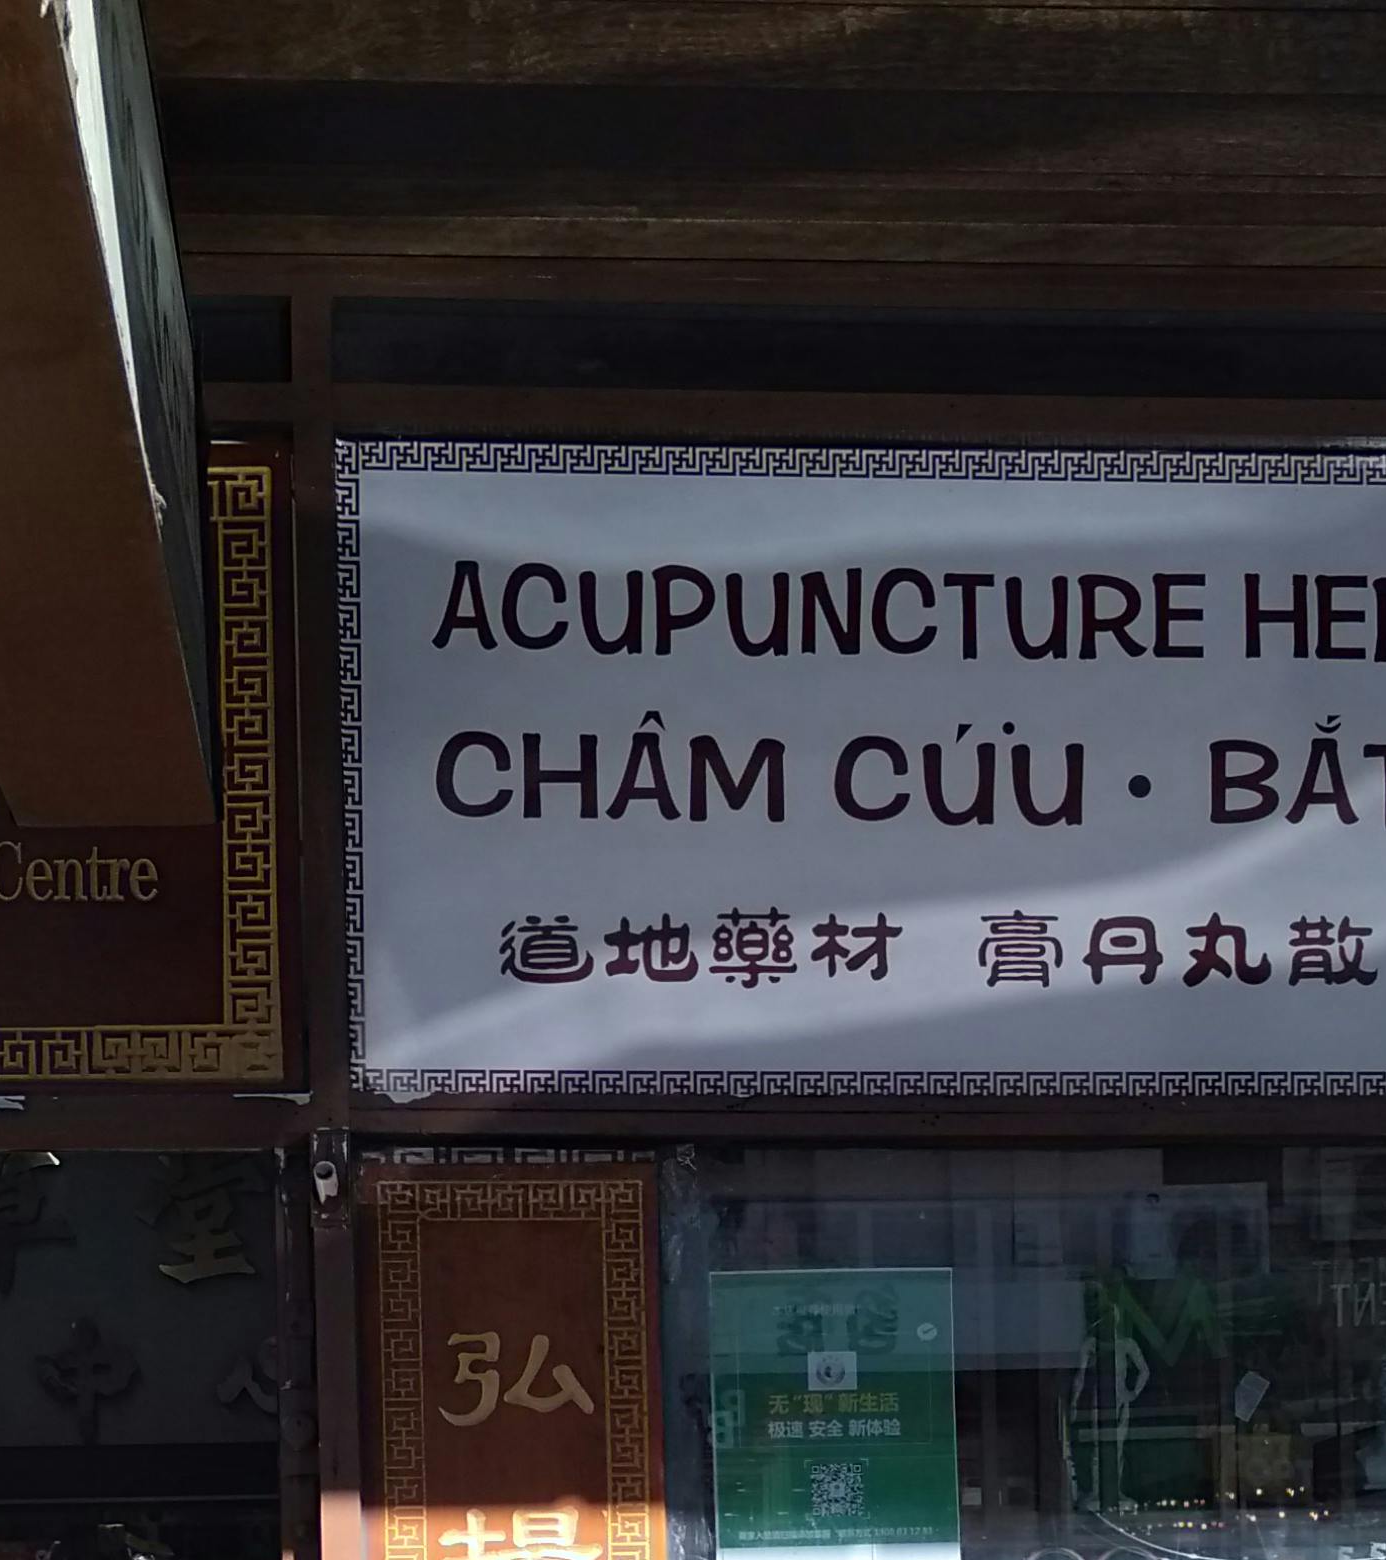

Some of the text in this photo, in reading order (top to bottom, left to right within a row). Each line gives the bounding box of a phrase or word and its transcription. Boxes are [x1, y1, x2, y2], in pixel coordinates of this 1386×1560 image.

[432, 560, 1206, 661] ACUPUNCTURE
[434, 710, 787, 824] CHÂM
[499, 907, 904, 990] 道地藥材
[977, 910, 1380, 989] 膏丹丸散
[808, 1420, 844, 1438] 安全
[848, 1418, 901, 1438] 新体验
